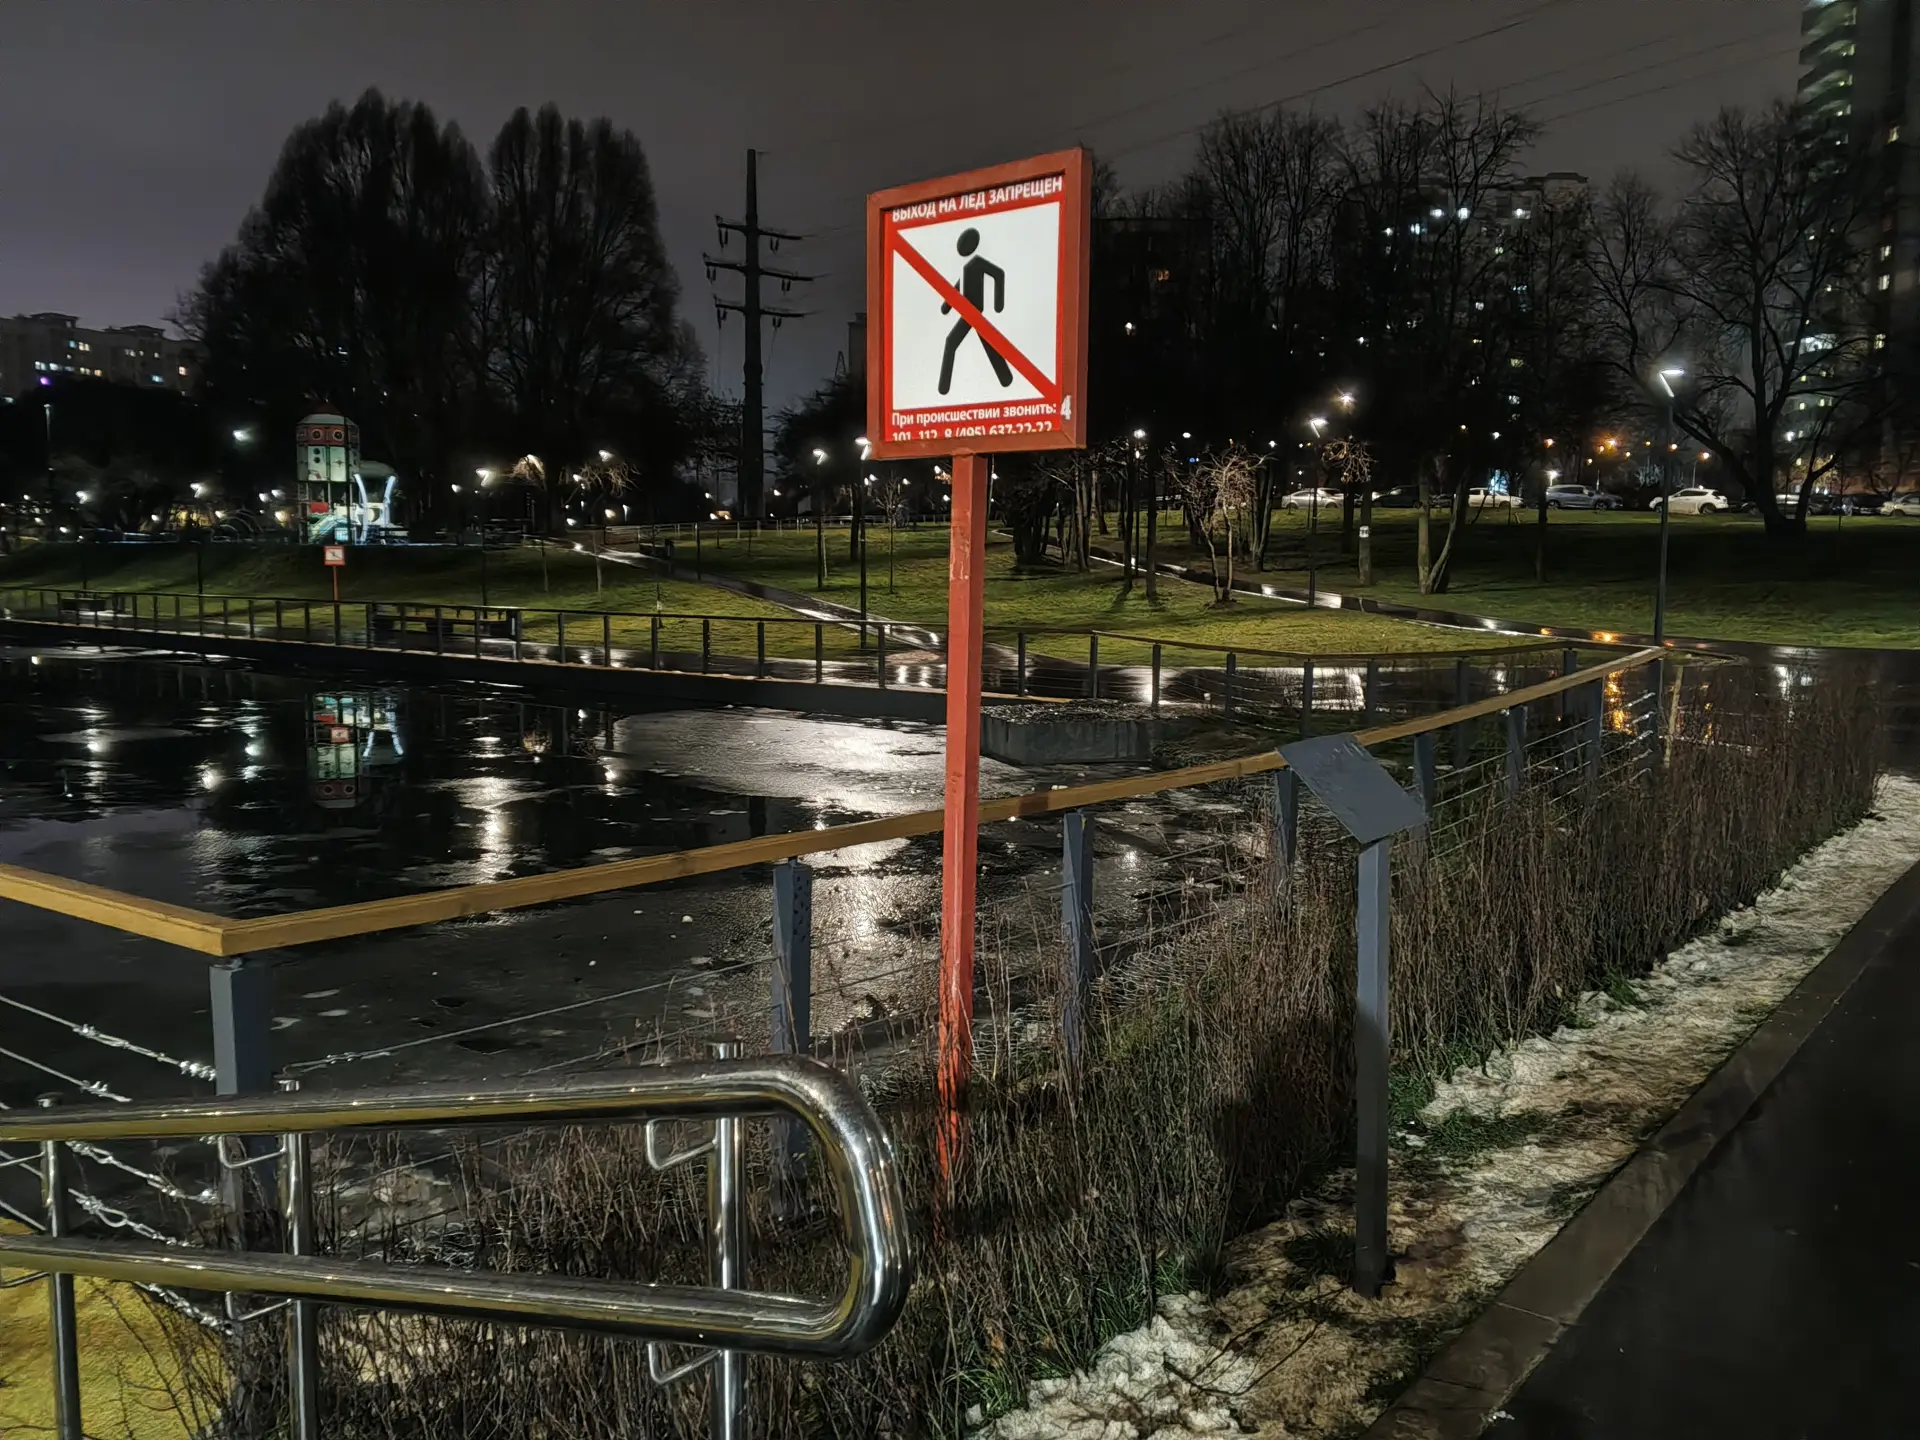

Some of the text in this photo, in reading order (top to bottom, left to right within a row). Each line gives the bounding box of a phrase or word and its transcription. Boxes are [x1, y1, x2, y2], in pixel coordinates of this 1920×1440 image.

[892, 175, 1063, 222] ВЫХОД НА ЛЕД ЗАПРЕЩЕН
[892, 403, 1057, 428] При происшествии звонить:
